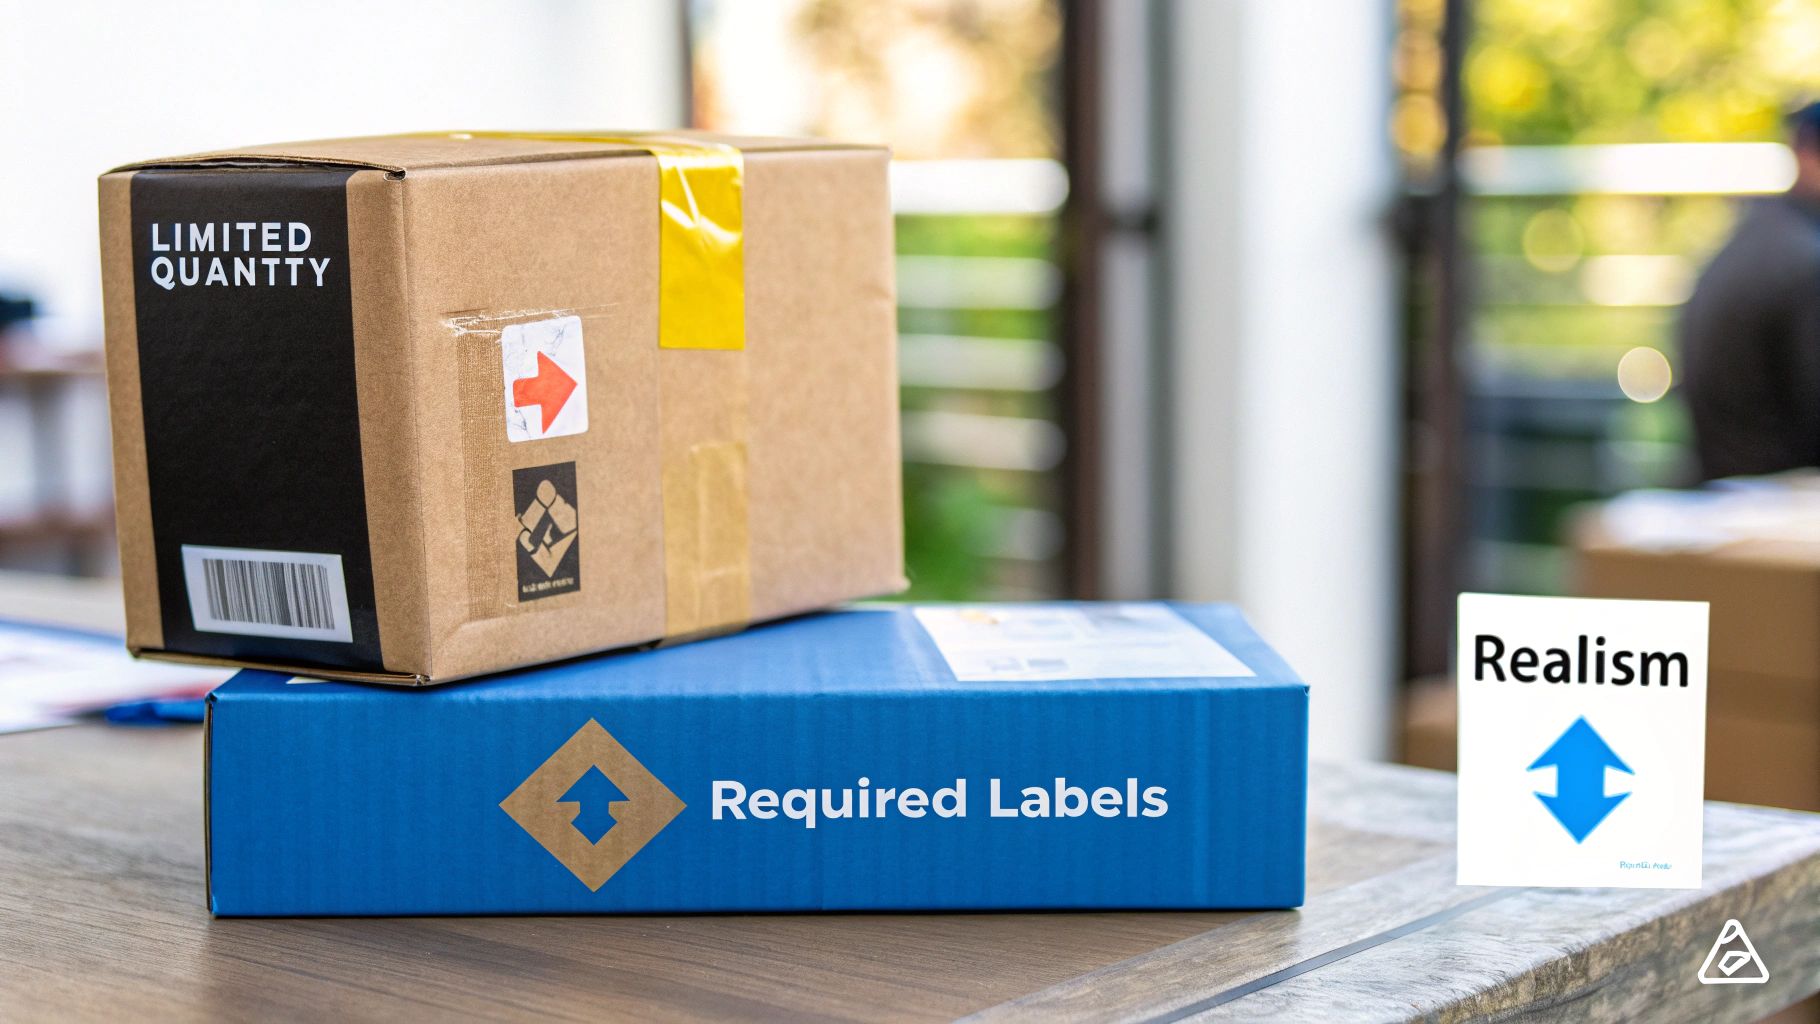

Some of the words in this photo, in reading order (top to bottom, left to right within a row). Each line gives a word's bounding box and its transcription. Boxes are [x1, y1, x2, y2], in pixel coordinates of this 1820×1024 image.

[152, 222, 312, 252] LIMITED
[151, 256, 331, 290] QUANTTY
[1474, 634, 1689, 688] Realism
[712, 777, 967, 829] Required
[990, 777, 1169, 818] Labels
